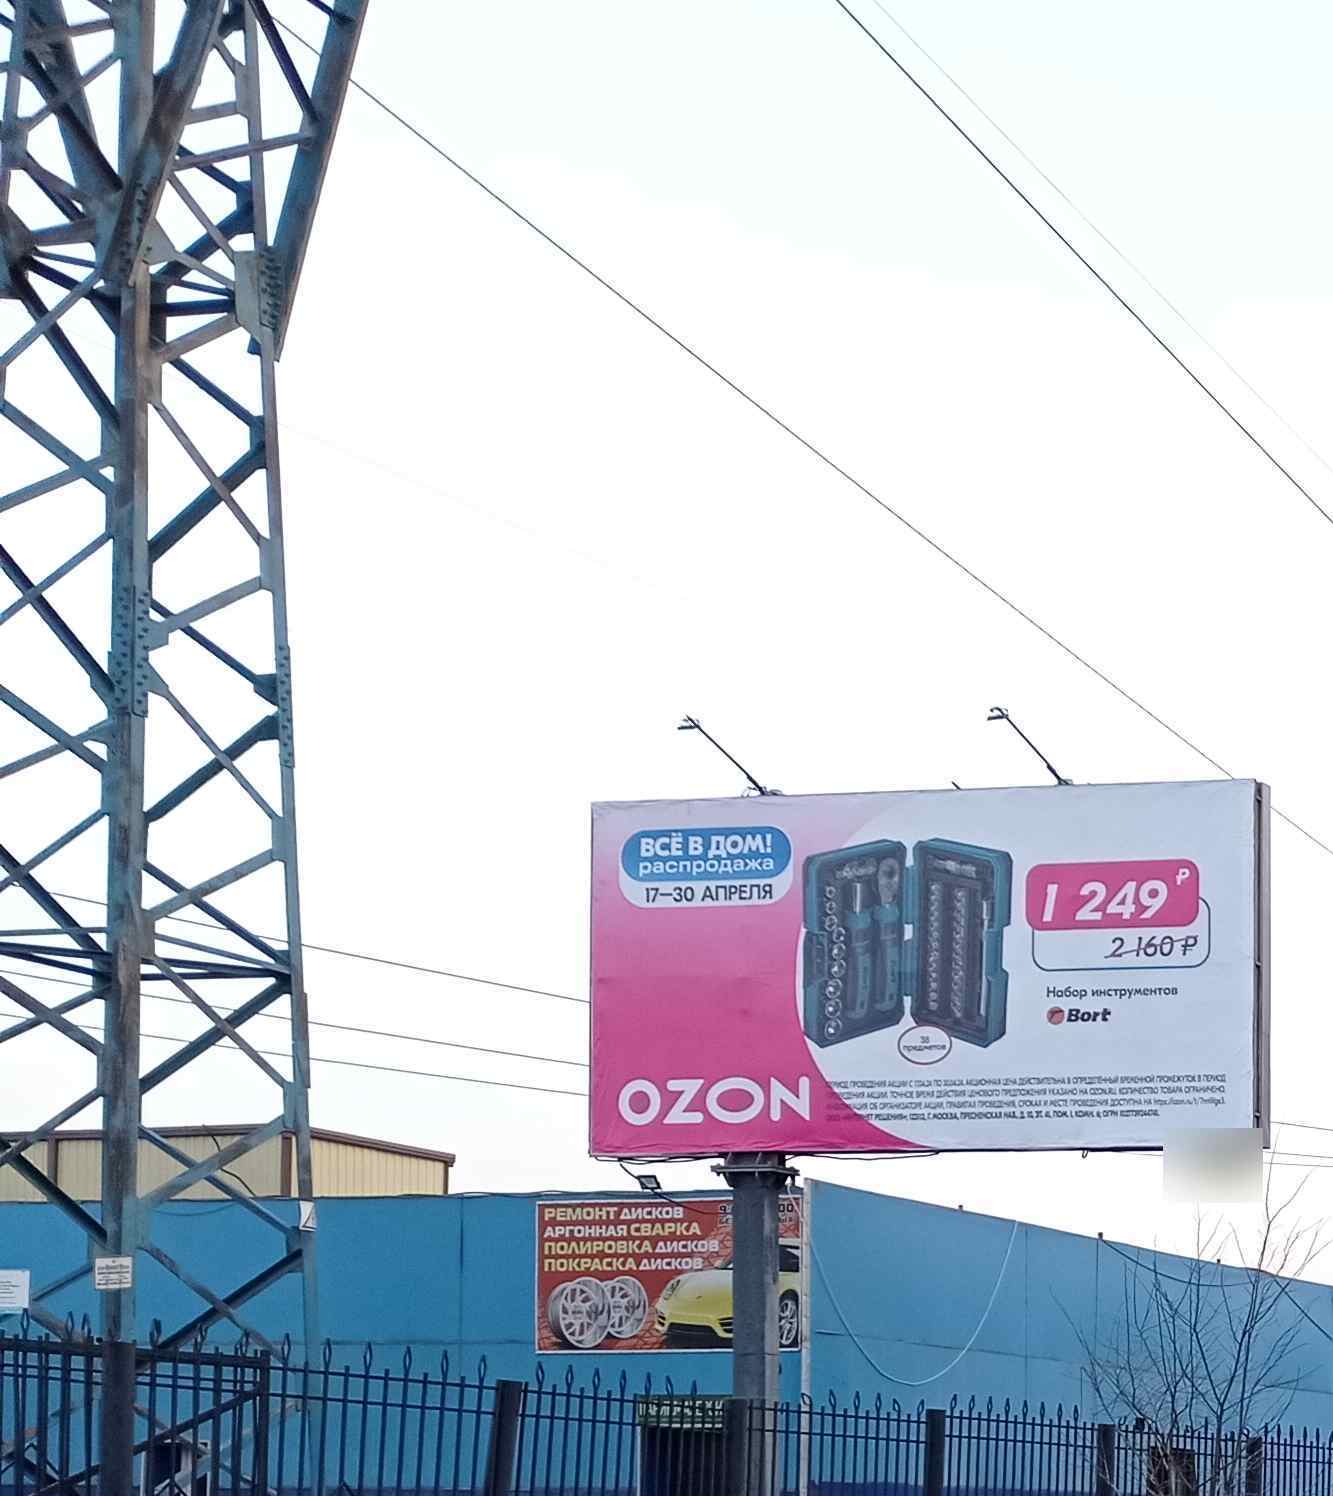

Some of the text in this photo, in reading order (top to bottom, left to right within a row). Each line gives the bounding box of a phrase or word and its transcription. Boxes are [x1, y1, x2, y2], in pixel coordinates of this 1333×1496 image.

[640, 833, 773, 858] ВСЁ В ДОМ!
[639, 857, 774, 877] распродажа
[701, 883, 773, 902] АПРЕЛЯ
[1075, 880, 1168, 921] 249
[1135, 935, 1175, 957] 160
[1046, 986, 1178, 1000] Набор инструментов
[1066, 1008, 1111, 1022] Bort
[618, 1076, 810, 1126] OZON
[544, 1206, 683, 1220] РЕМОНТ ДИСКОВ
[544, 1222, 701, 1238] АРГОННАЯ СВАРКА
[544, 1240, 719, 1255] ПОЛИРОВКА ДИСКОВ
[544, 1257, 703, 1271] ПОКРАСКА ДИСКОВ
